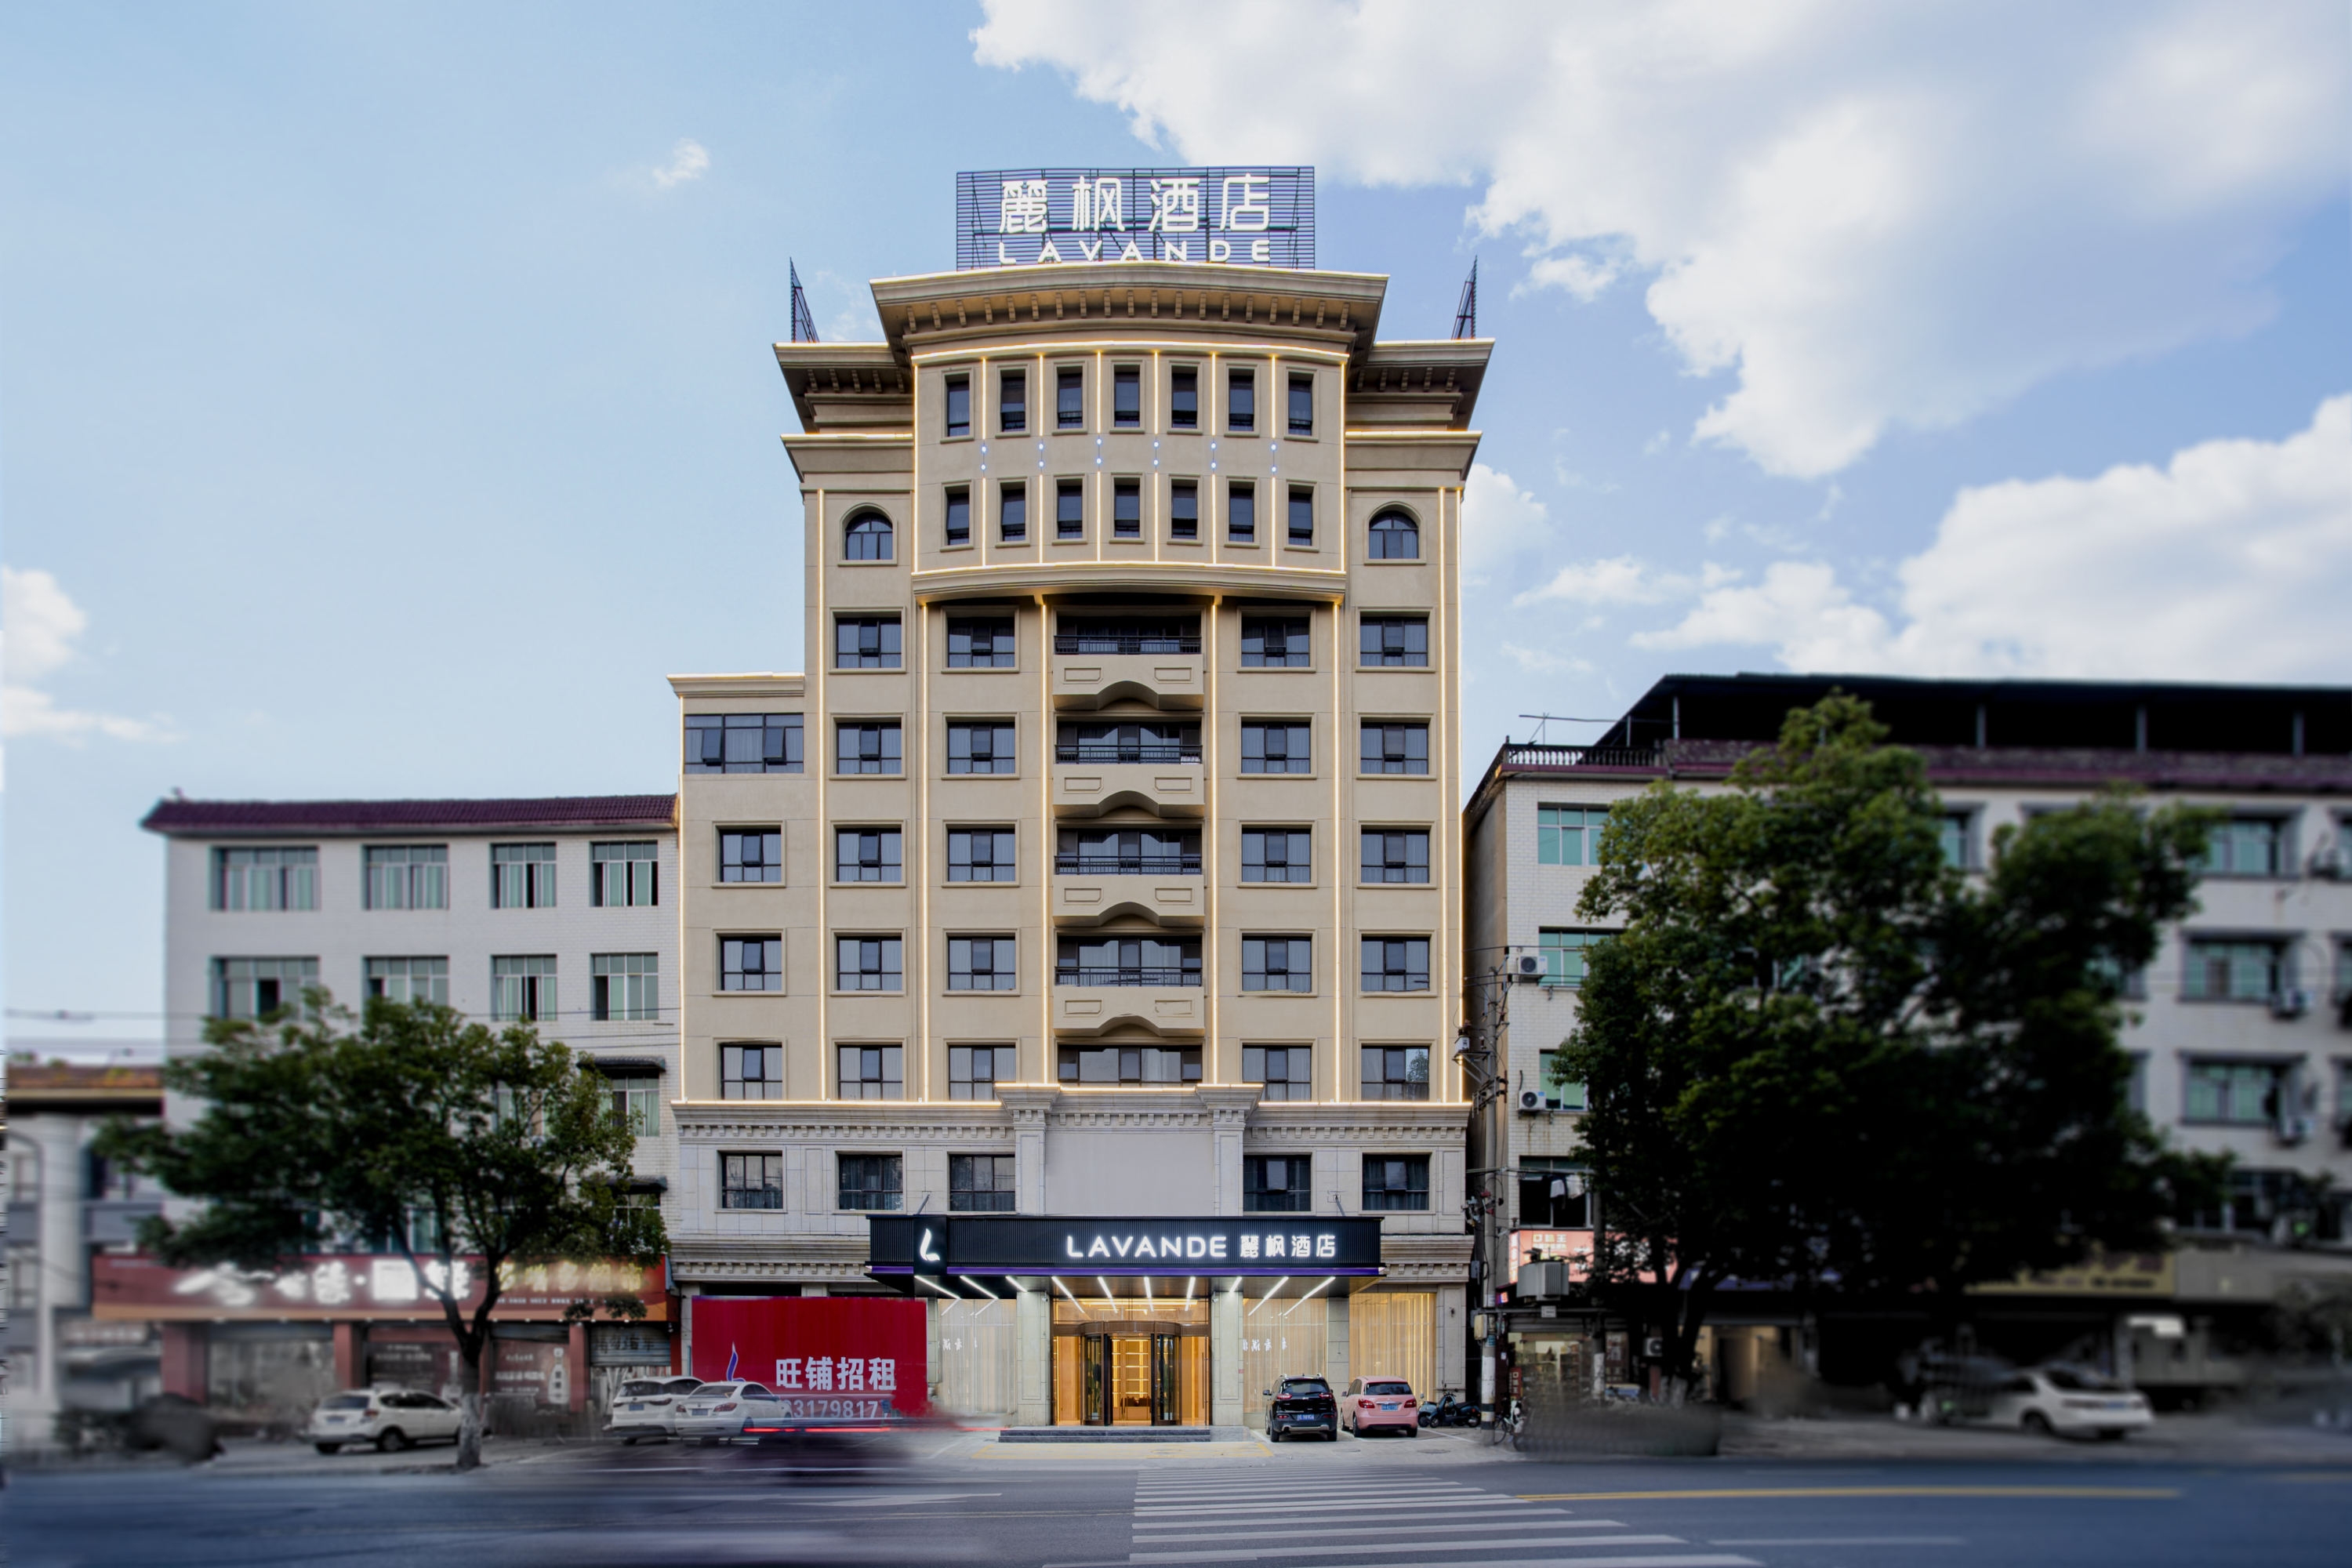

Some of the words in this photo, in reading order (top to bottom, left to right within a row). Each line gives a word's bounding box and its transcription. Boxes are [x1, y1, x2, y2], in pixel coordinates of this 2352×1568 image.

[999, 173, 1270, 234] 麗枫酒店
[999, 239, 1270, 264] LAVANDE
[1067, 1235, 1227, 1258] LAVANDE
[1240, 1234, 1336, 1259] 麗枫酒店
[775, 1356, 897, 1392] 旺铺招租
[783, 1399, 888, 1420] 3179817
